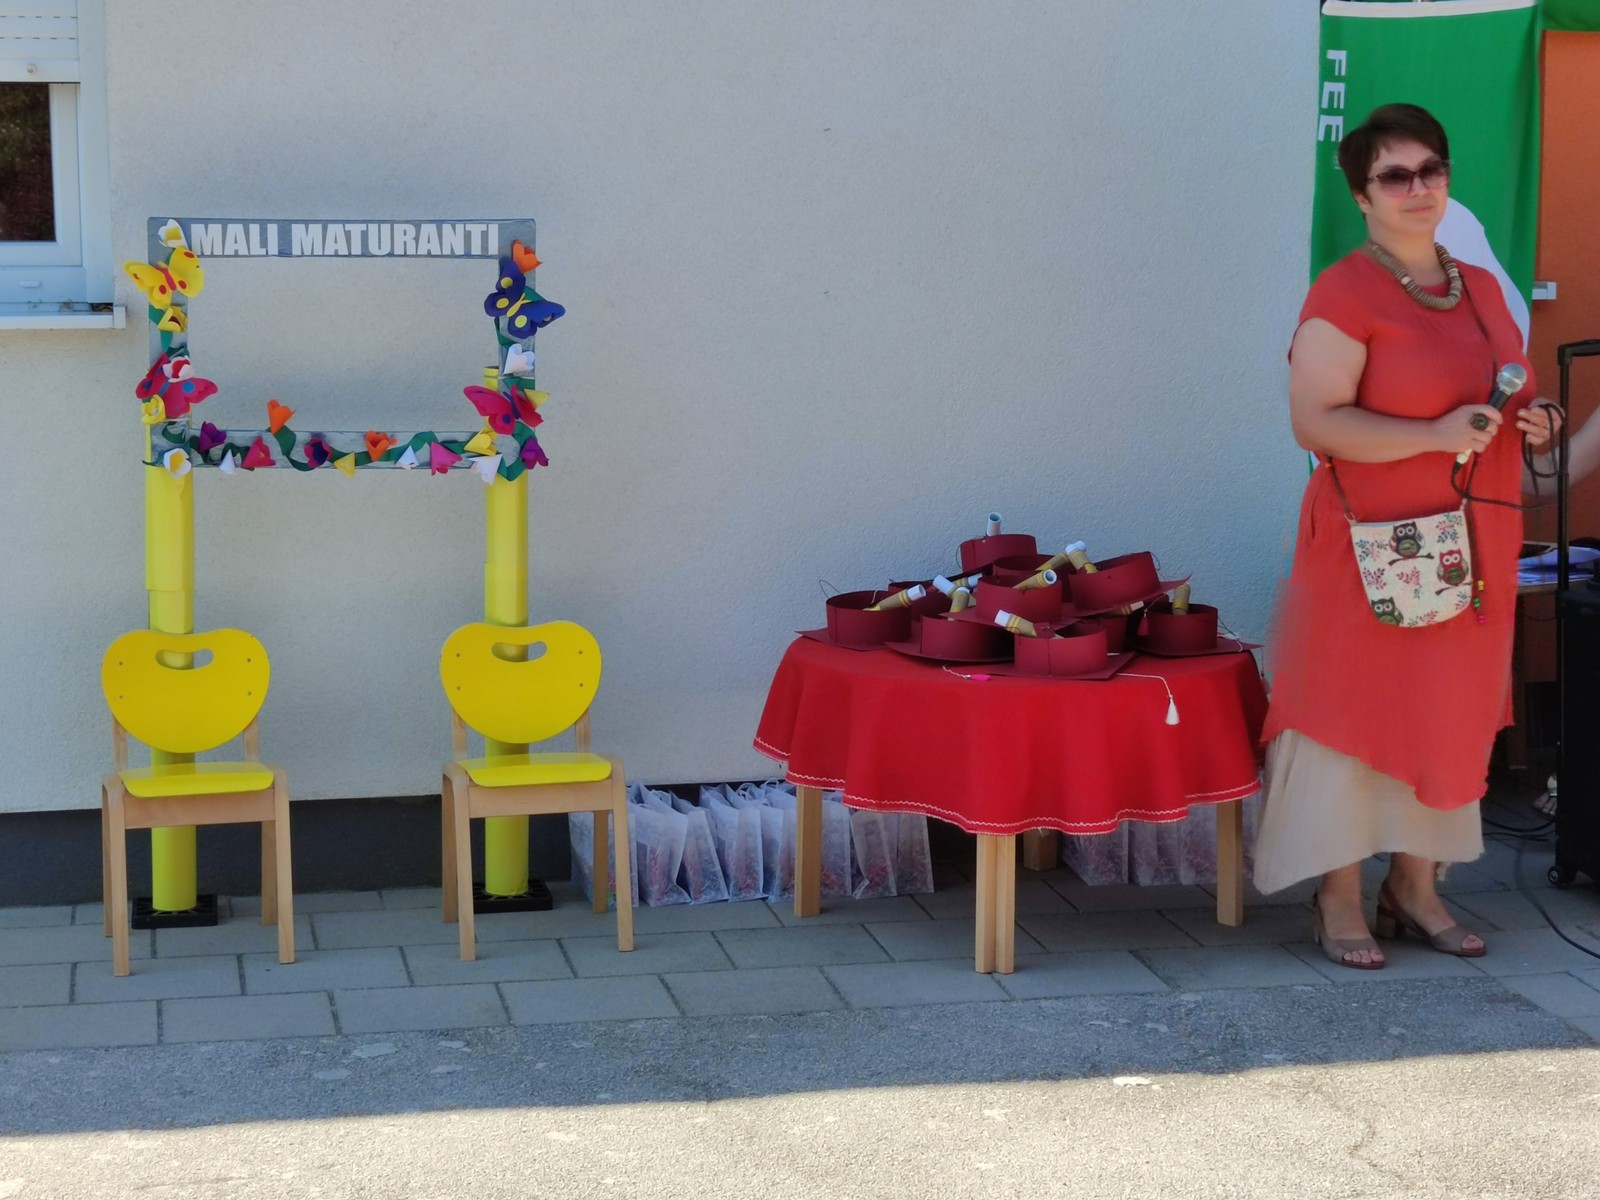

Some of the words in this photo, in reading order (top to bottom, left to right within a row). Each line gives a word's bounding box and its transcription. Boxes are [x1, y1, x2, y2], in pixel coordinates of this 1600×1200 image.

[1318, 49, 1347, 142] FEE
[190, 223, 279, 256] MALI
[291, 223, 499, 256] MATURANTI
